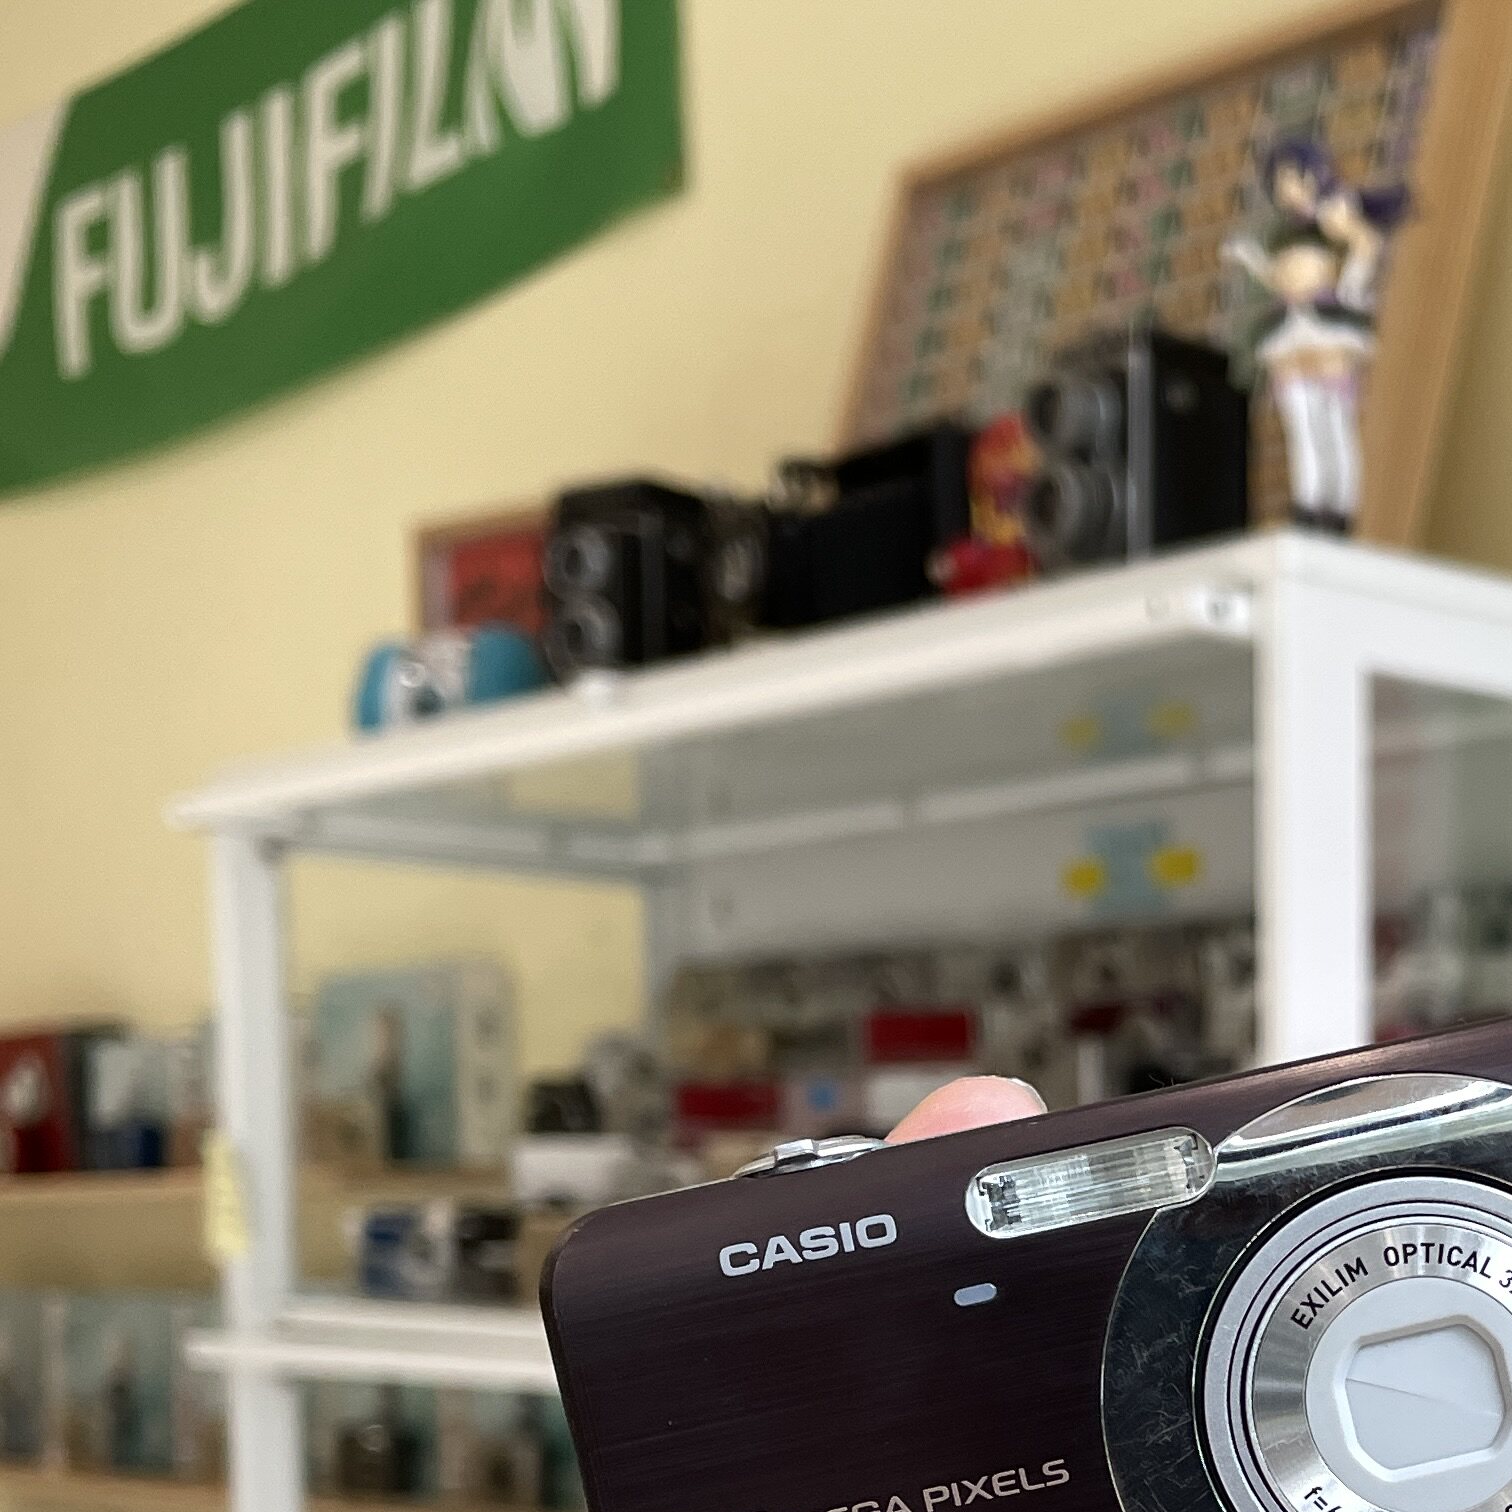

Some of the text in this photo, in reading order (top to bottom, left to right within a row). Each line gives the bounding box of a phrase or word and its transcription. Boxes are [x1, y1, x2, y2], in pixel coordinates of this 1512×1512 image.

[50, 0, 622, 381] FUJIFILM
[718, 1213, 898, 1277] CASIO
[1290, 1257, 1369, 1330] EXILIM
[1383, 1242, 1492, 1279] OPTICAL
[923, 1459, 1070, 1512] PIXELS
